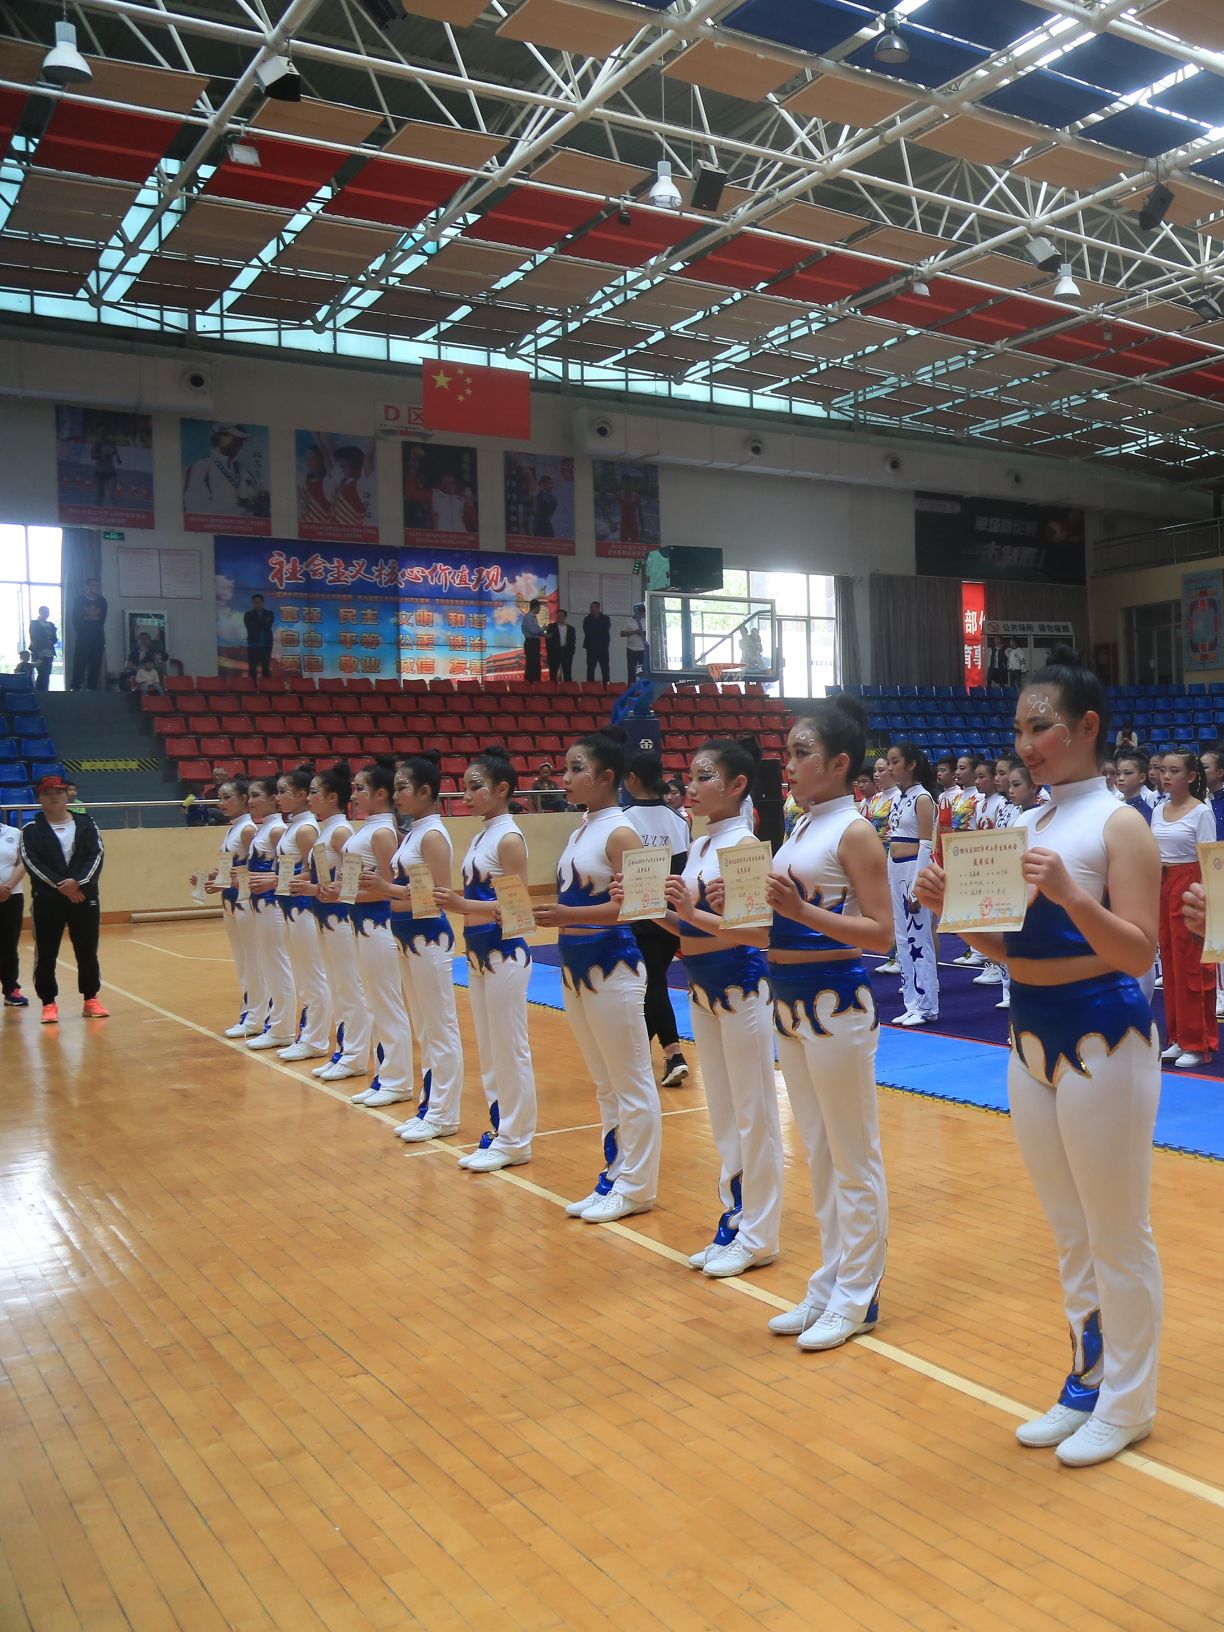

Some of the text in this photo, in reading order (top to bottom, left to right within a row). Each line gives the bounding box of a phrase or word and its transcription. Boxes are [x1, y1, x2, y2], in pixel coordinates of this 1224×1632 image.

[279, 605, 488, 629] 富强 民主 文明 和谐
[280, 630, 488, 652] 自由 平等 公正 法治
[280, 654, 488, 676] 爱国 敬业 诚信 友善
